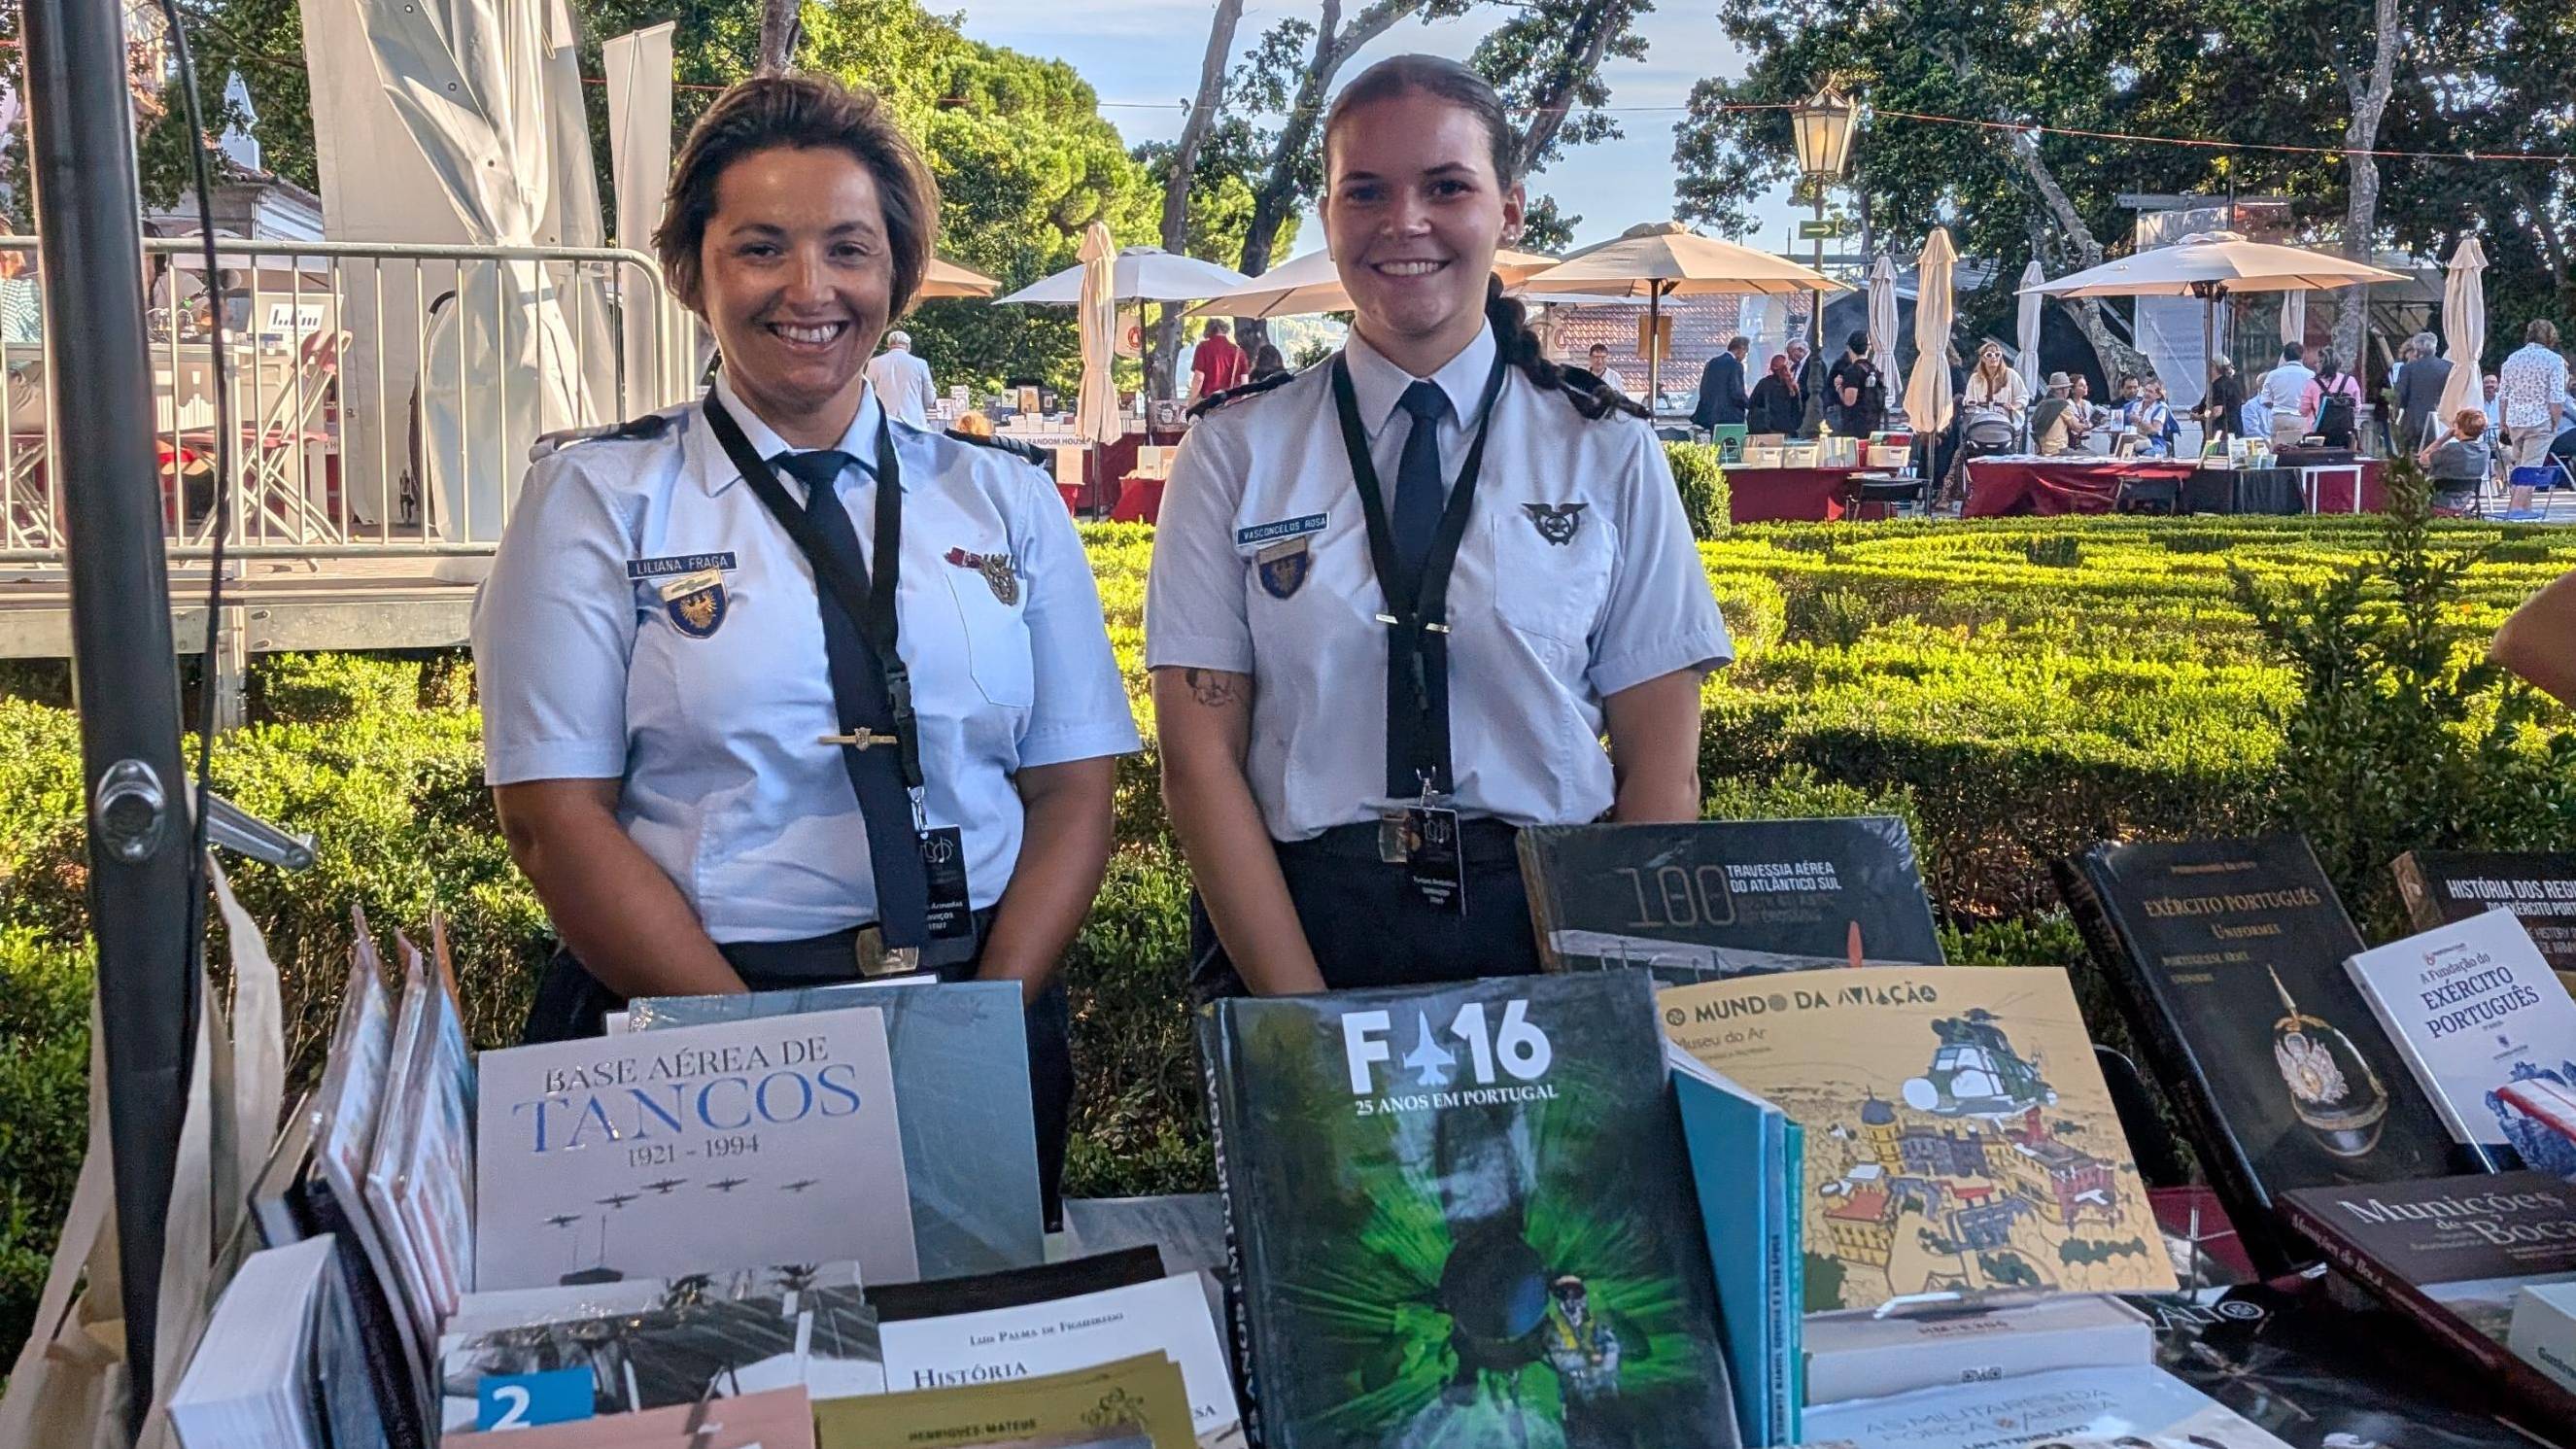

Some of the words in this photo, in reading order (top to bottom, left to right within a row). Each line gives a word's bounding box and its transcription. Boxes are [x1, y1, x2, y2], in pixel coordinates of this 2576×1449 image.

[1244, 522, 1300, 540] VASCONCELOS
[1304, 516, 1326, 530] ROSA
[635, 559, 682, 575] LILIANA
[689, 555, 729, 570] FRAGA
[1616, 864, 1735, 928] 100
[1726, 863, 1793, 879] TRAVESSIA
[1795, 860, 1835, 876] AÉREA
[1730, 879, 1749, 893] DO
[1750, 877, 1817, 892] ATLÂNTICO
[1818, 877, 1842, 890] SUL
[2446, 877, 2515, 899] HISTÓRIA
[2513, 880, 2543, 899] DOS
[2144, 895, 2224, 917] EXÉRCITO
[2224, 886, 2321, 912] PORTUGUÊS
[2421, 973, 2431, 984] A
[2427, 957, 2478, 982] Fundação
[2477, 952, 2490, 965] do
[1695, 993, 1788, 1022] MUNDO
[1794, 990, 1831, 1010] DA
[1838, 981, 1938, 1006] AVIAÇÃO
[2420, 966, 2515, 1011] EXÉRCITO
[2425, 984, 2540, 1039] PORTUGUÊS
[1672, 1032, 1721, 1049] Museu
[1725, 1030, 1744, 1043] do
[1747, 1027, 1767, 1041] Ar
[545, 1058, 637, 1094] BASE
[648, 1044, 771, 1082] AÉREA
[782, 1036, 830, 1065] DE
[512, 1063, 862, 1154] TANCOS
[1355, 1099, 1374, 1117] 25
[1377, 1094, 1429, 1115] ANOS
[1433, 1092, 1460, 1109] EM
[1463, 1084, 1561, 1107] PORTUGAL
[628, 1145, 674, 1169] 1921
[705, 1134, 760, 1158] 1994
[1205, 1058, 1234, 1234] PORTUGAL
[2337, 1192, 2565, 1224] Munições
[2436, 1219, 2463, 1230] de
[913, 1361, 1028, 1388] HISTÓRIA
[491, 1386, 532, 1432] 2
